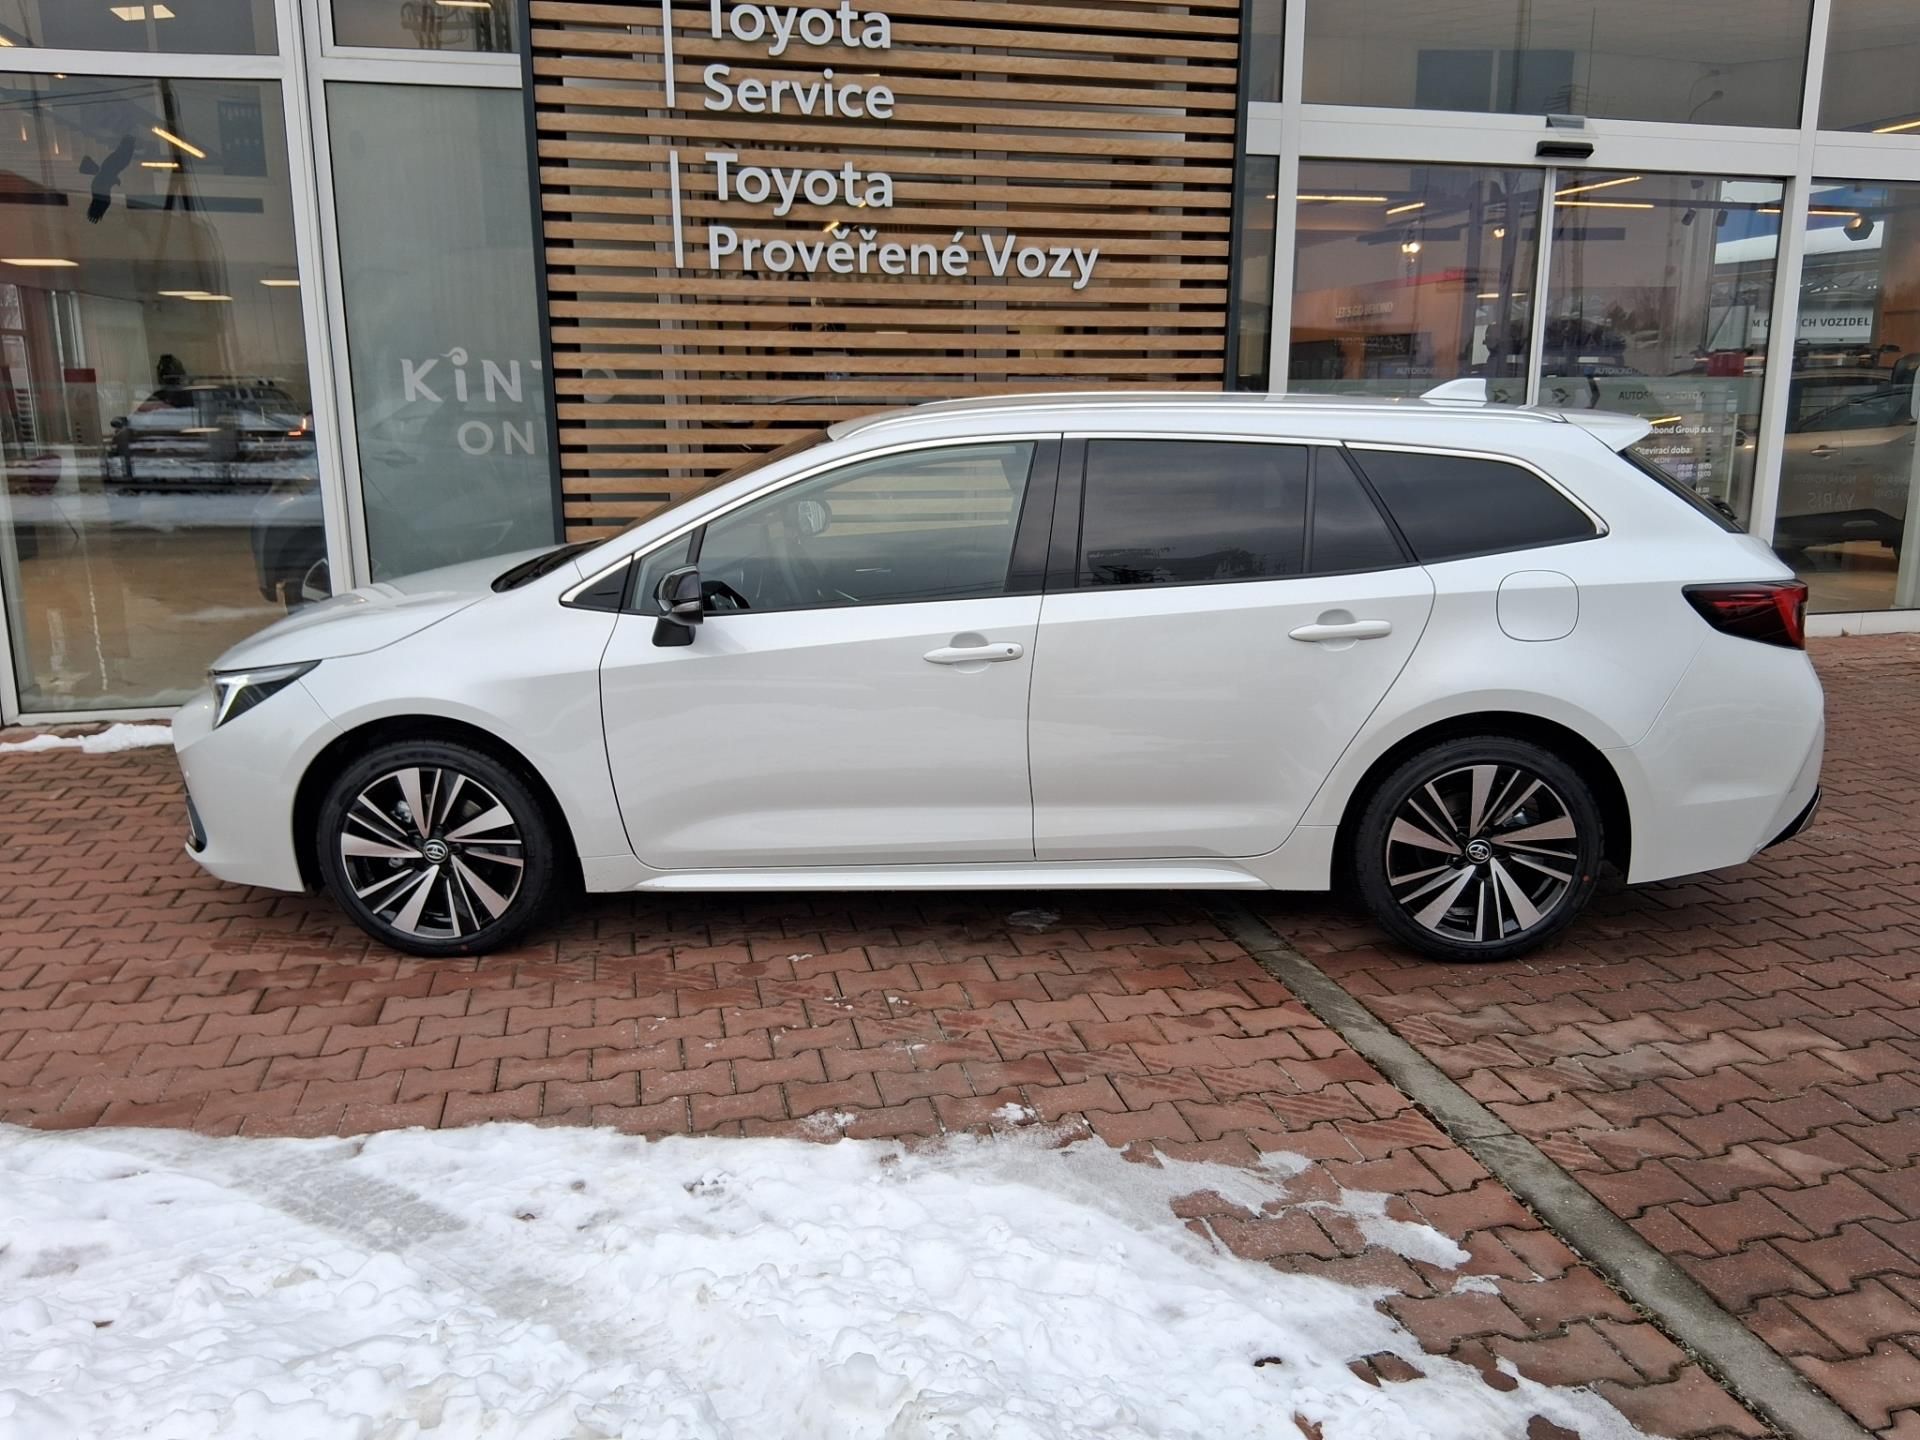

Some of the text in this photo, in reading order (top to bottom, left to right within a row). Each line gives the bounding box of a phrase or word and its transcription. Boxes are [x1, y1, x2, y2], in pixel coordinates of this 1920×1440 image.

[707, 0, 892, 56] Toyota
[703, 63, 895, 120] Service
[705, 152, 894, 217] Toyota
[708, 226, 1100, 290] Prověřené Vozy
[1819, 317, 1871, 328] VOZIDEL
[1671, 446, 1693, 454] doba:
[1675, 425, 1700, 435] Group
